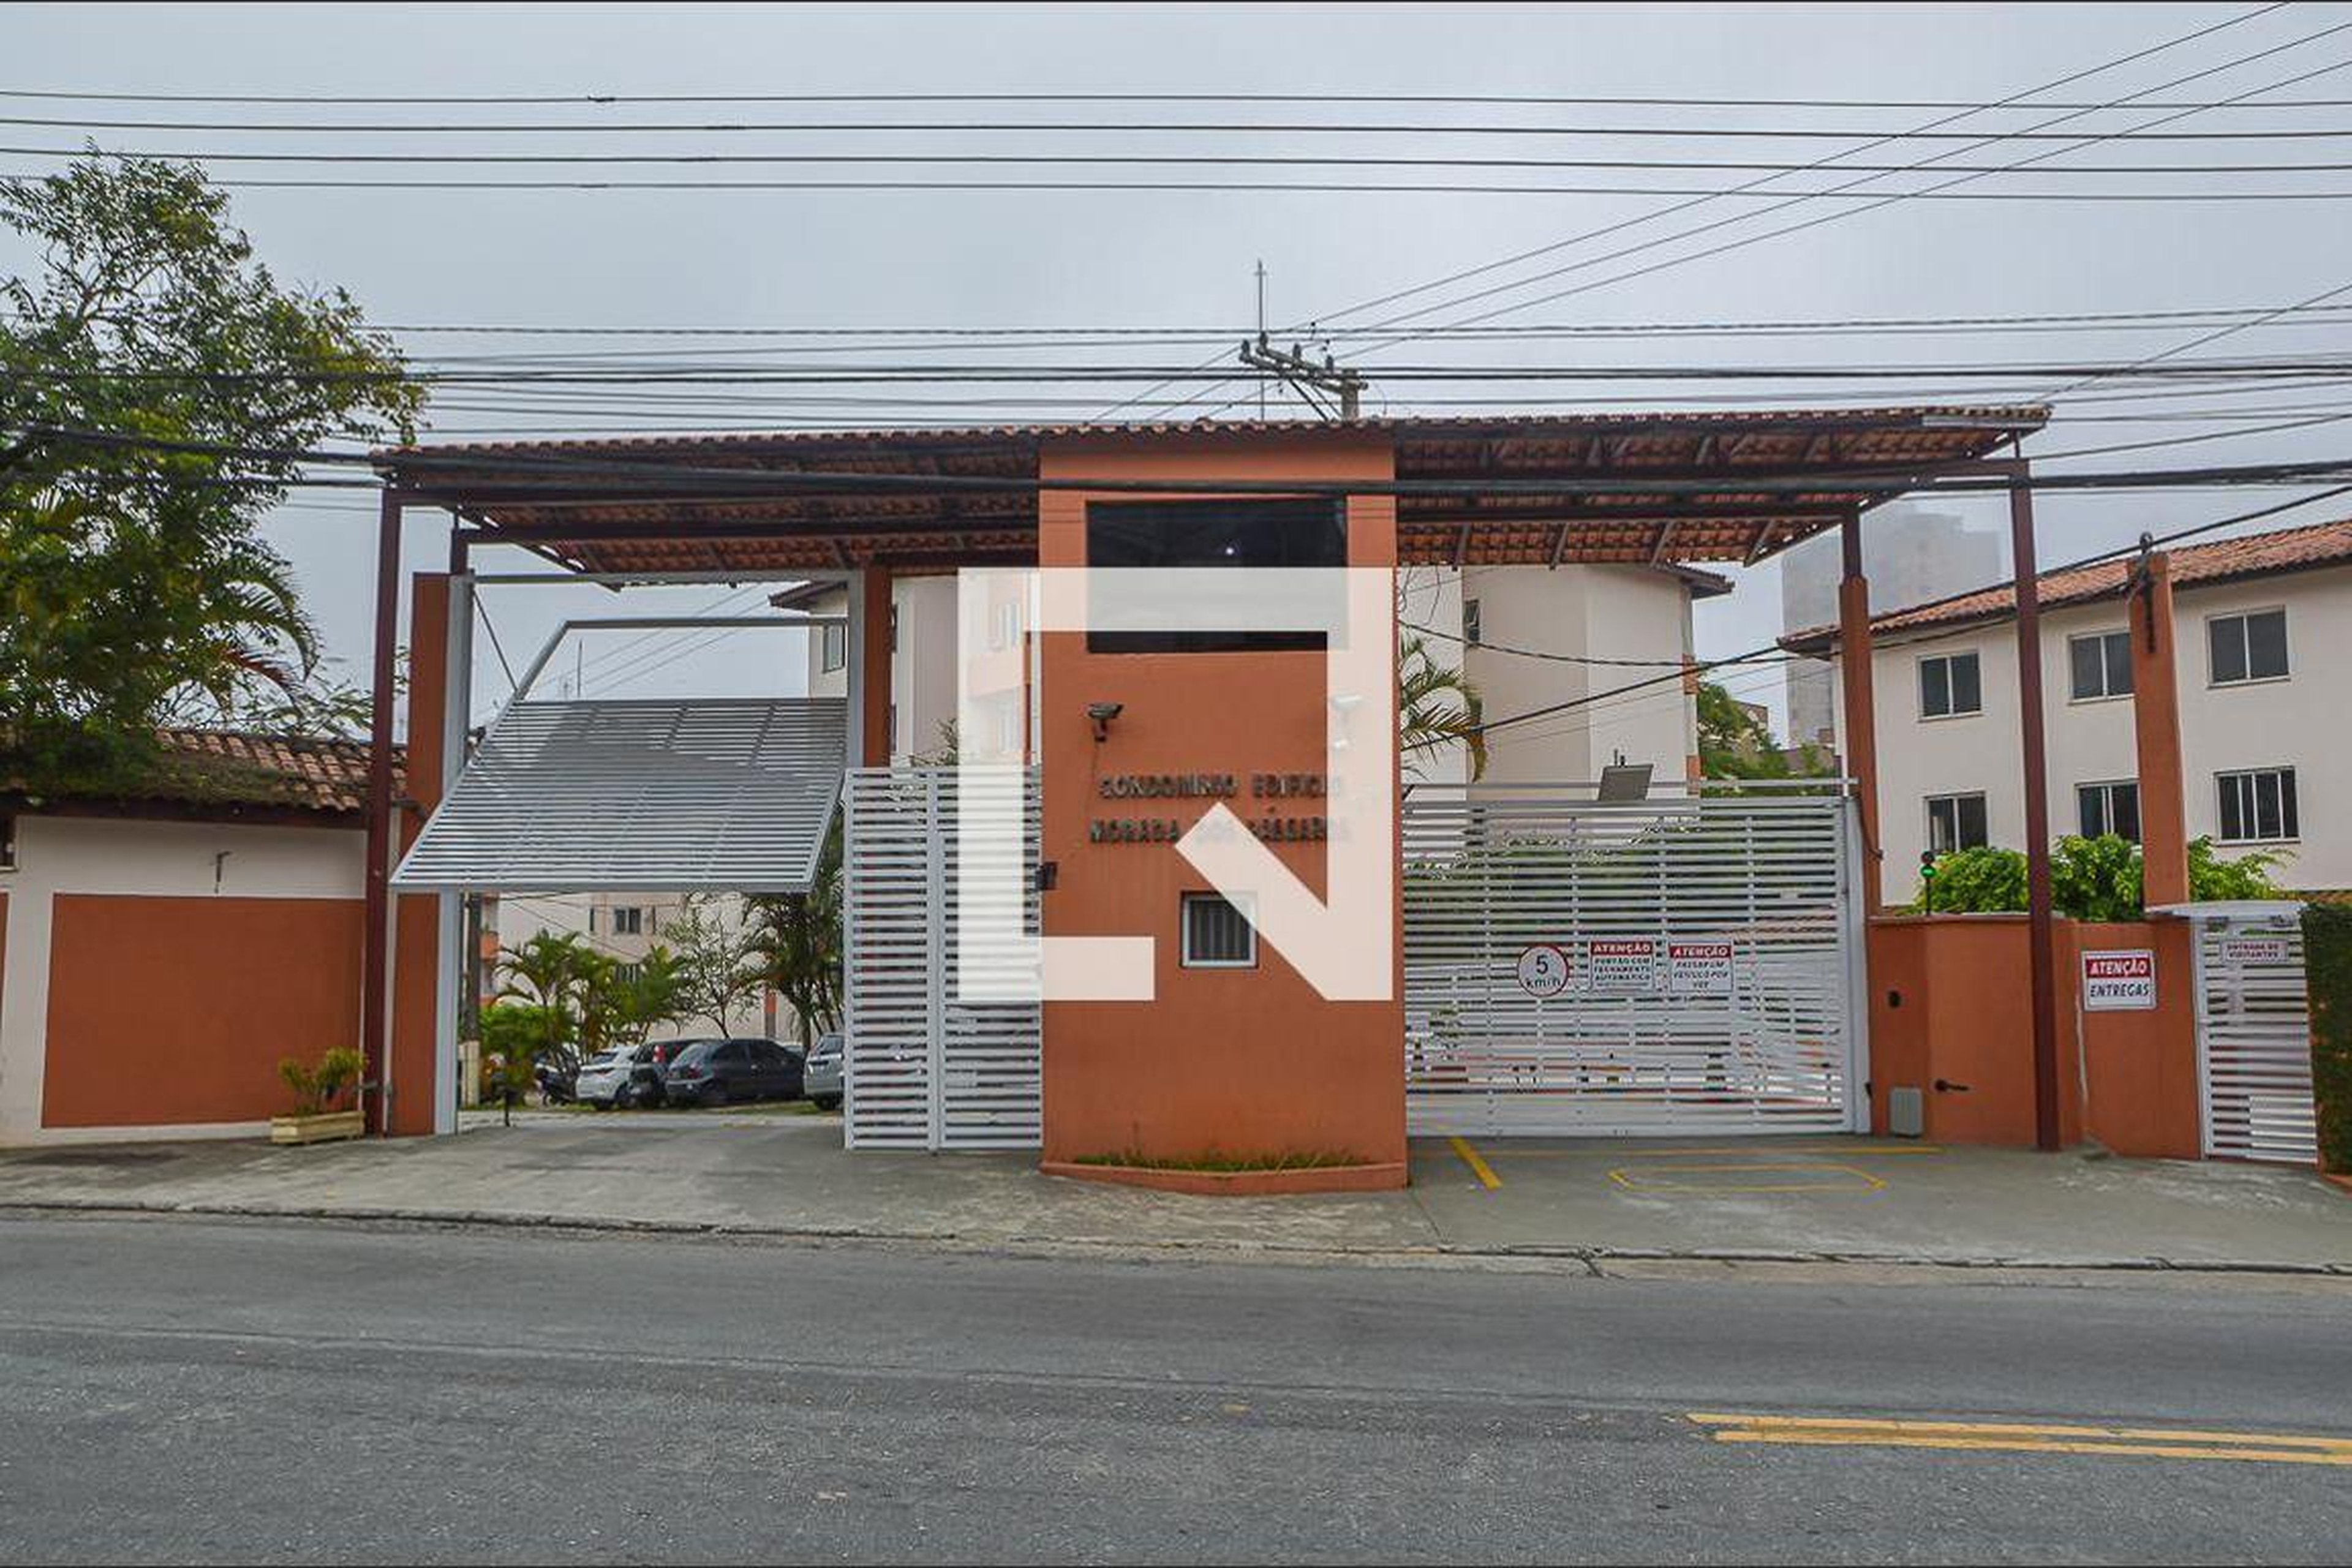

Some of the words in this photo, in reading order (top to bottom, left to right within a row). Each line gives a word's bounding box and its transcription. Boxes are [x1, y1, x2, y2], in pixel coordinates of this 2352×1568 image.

[1253, 774, 1344, 798] EDIFICI
[1090, 818, 1180, 844] MORADA
[1593, 941, 1651, 955] ATENÇÃO
[1673, 946, 1728, 958] ATENÇÃO
[1536, 954, 1548, 974] 5
[2089, 959, 2147, 977] ATENÇÃO
[1525, 977, 1561, 989] km/h
[2090, 982, 2149, 998] ENTREGAS
